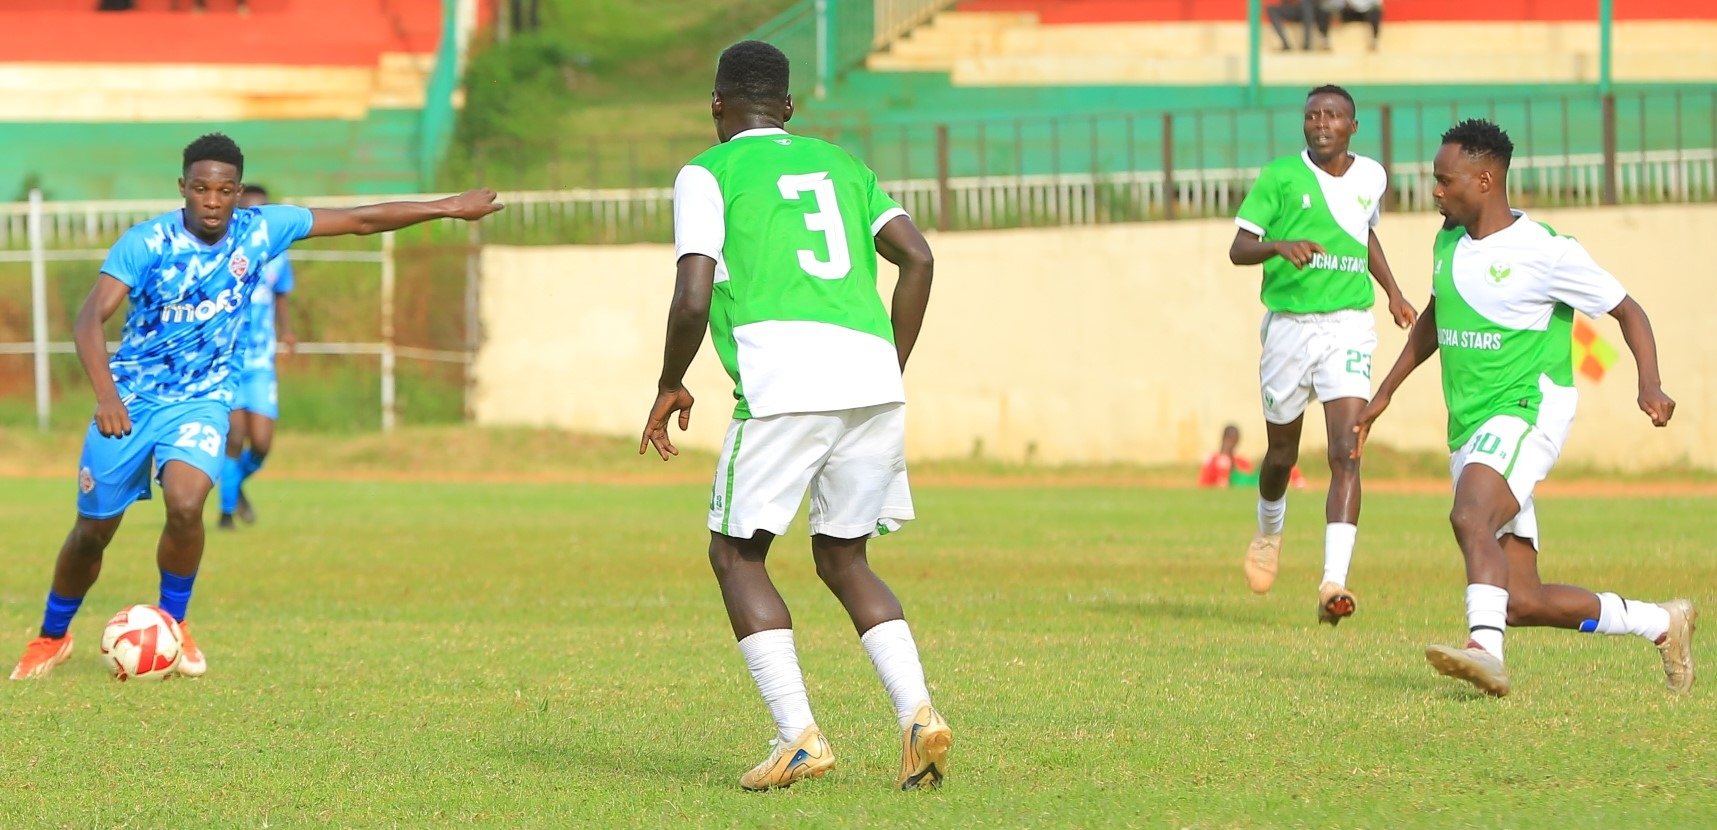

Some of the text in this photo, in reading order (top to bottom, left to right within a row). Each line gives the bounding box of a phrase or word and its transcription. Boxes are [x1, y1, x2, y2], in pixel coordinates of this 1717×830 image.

[776, 171, 852, 280] 3
[1461, 331, 1502, 350] STARS
[1345, 349, 1371, 380] 23
[173, 421, 221, 457] 23
